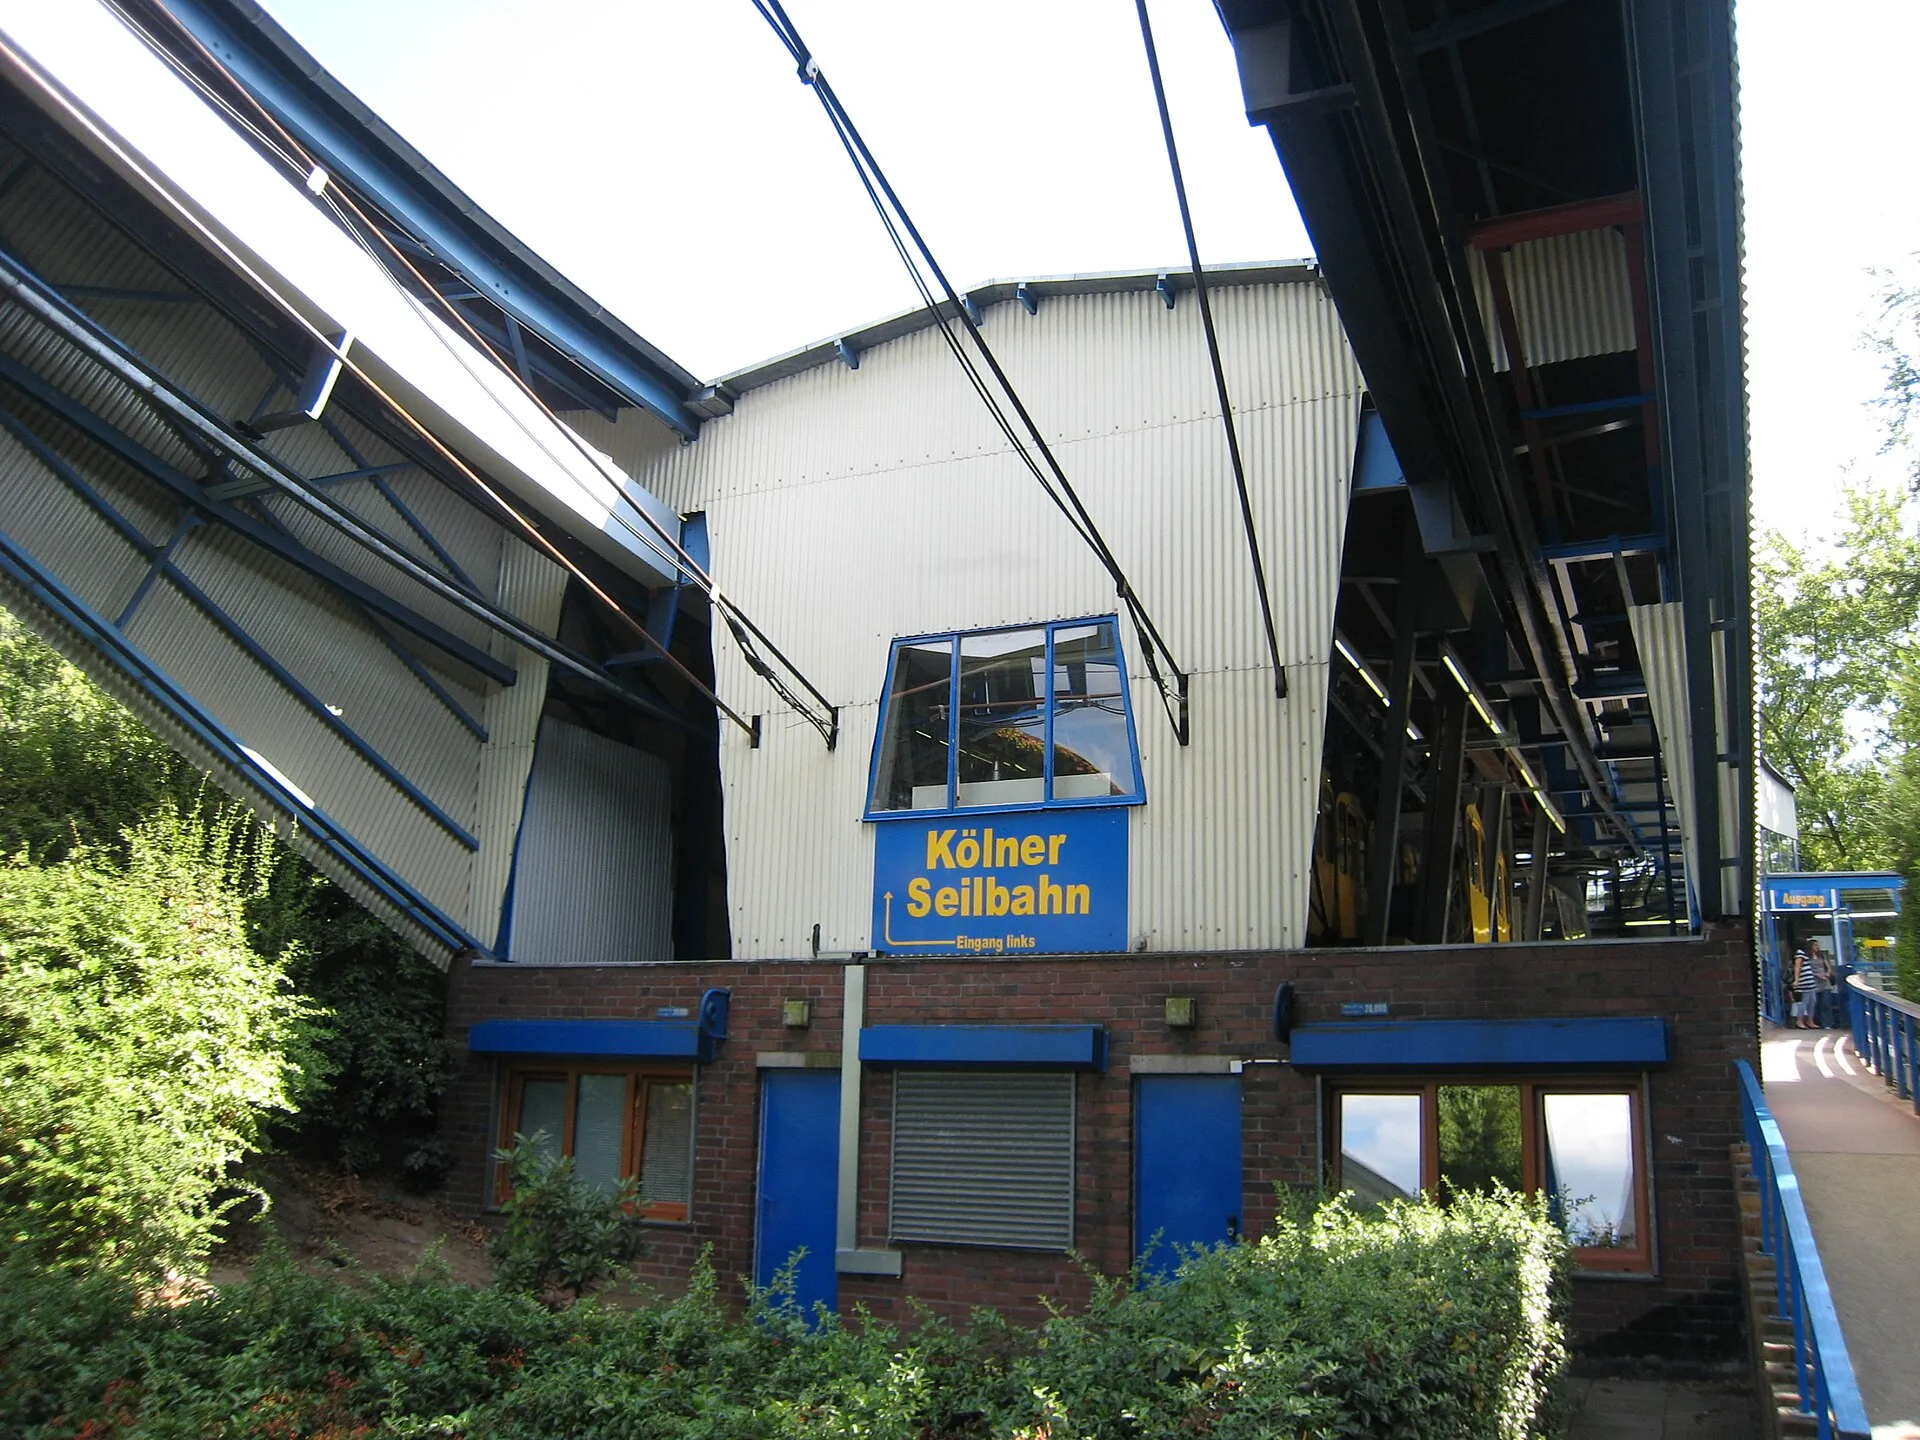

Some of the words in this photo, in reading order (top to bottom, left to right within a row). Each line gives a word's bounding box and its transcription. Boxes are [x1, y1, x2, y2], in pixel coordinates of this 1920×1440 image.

[926, 828, 1067, 870] Kölner
[906, 874, 1091, 918] Seilbahn
[1783, 892, 1826, 907] Ausgang
[956, 935, 1003, 952] Eingang
[1006, 934, 1036, 949] links
